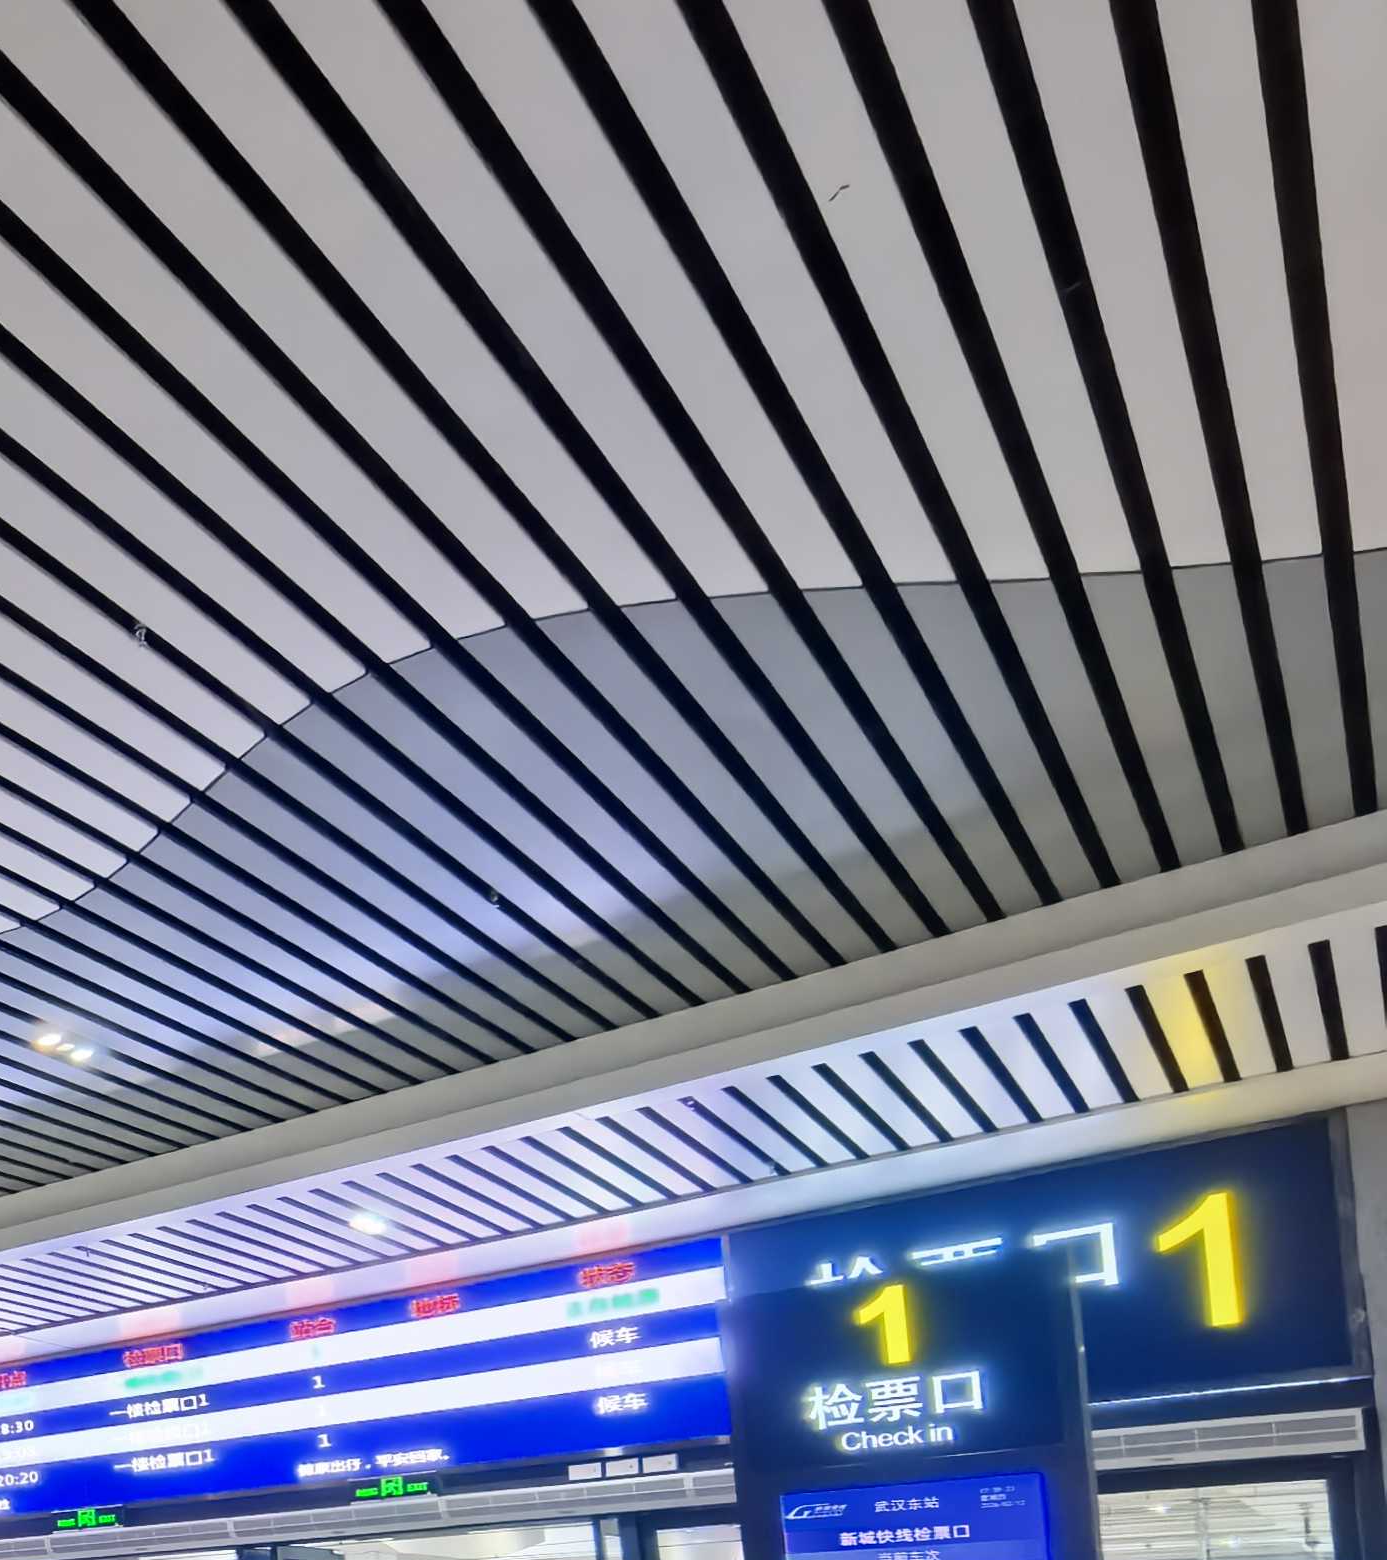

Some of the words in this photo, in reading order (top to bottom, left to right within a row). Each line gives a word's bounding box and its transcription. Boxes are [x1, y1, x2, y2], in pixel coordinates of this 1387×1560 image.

[1155, 1190, 1244, 1328] 1
[123, 1343, 184, 1368] 检票口
[579, 1262, 635, 1287] 状态
[853, 1283, 913, 1366] 1
[312, 1375, 325, 1389] 1
[589, 1326, 640, 1348] 候车
[318, 1433, 331, 1448] 1
[596, 1392, 648, 1414] 候车
[808, 1369, 985, 1431] 检票口
[840, 1424, 923, 1453] Check
[925, 1423, 954, 1444] in
[839, 1524, 970, 1546] 新城快线检票口
[874, 1496, 940, 1513] 武汉东站
